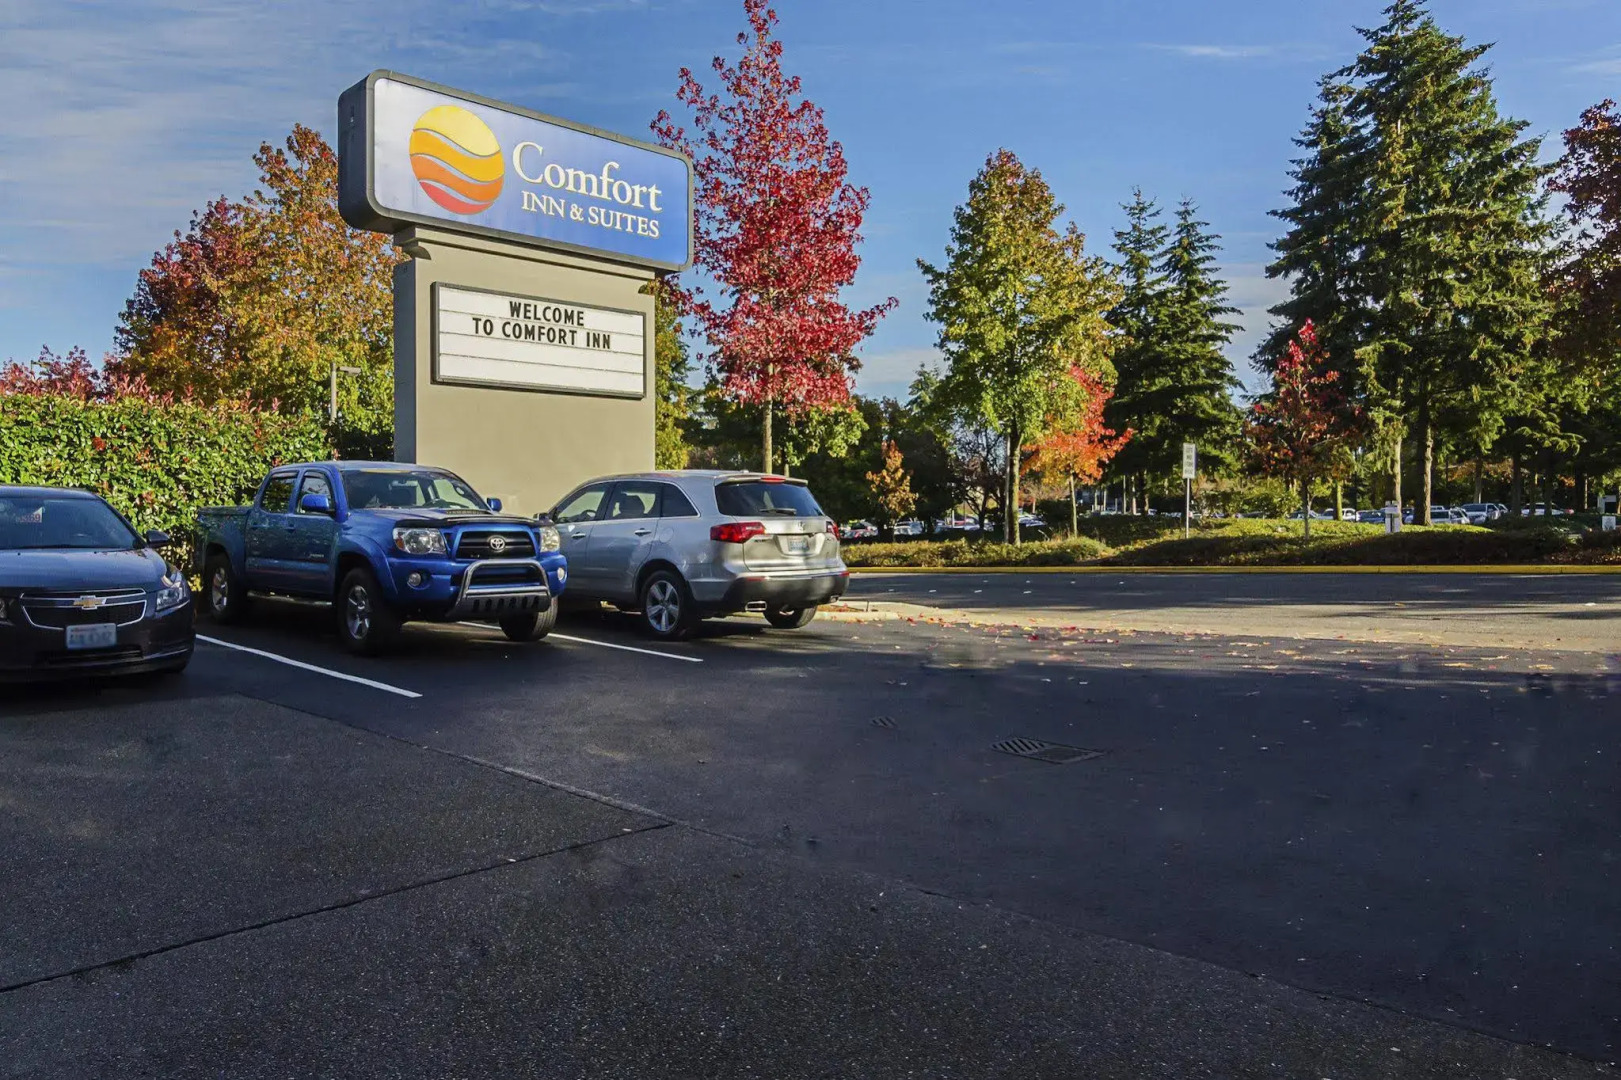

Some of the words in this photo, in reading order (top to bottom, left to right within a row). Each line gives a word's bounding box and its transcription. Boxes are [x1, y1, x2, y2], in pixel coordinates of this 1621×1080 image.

[512, 141, 663, 212] Comfort
[521, 190, 566, 218] INN
[569, 203, 585, 222] &
[588, 206, 661, 239] SUITES
[472, 317, 494, 336] TO
[502, 321, 578, 346] COMFORT
[586, 332, 611, 350] INN
[509, 300, 585, 327] WELCOME
